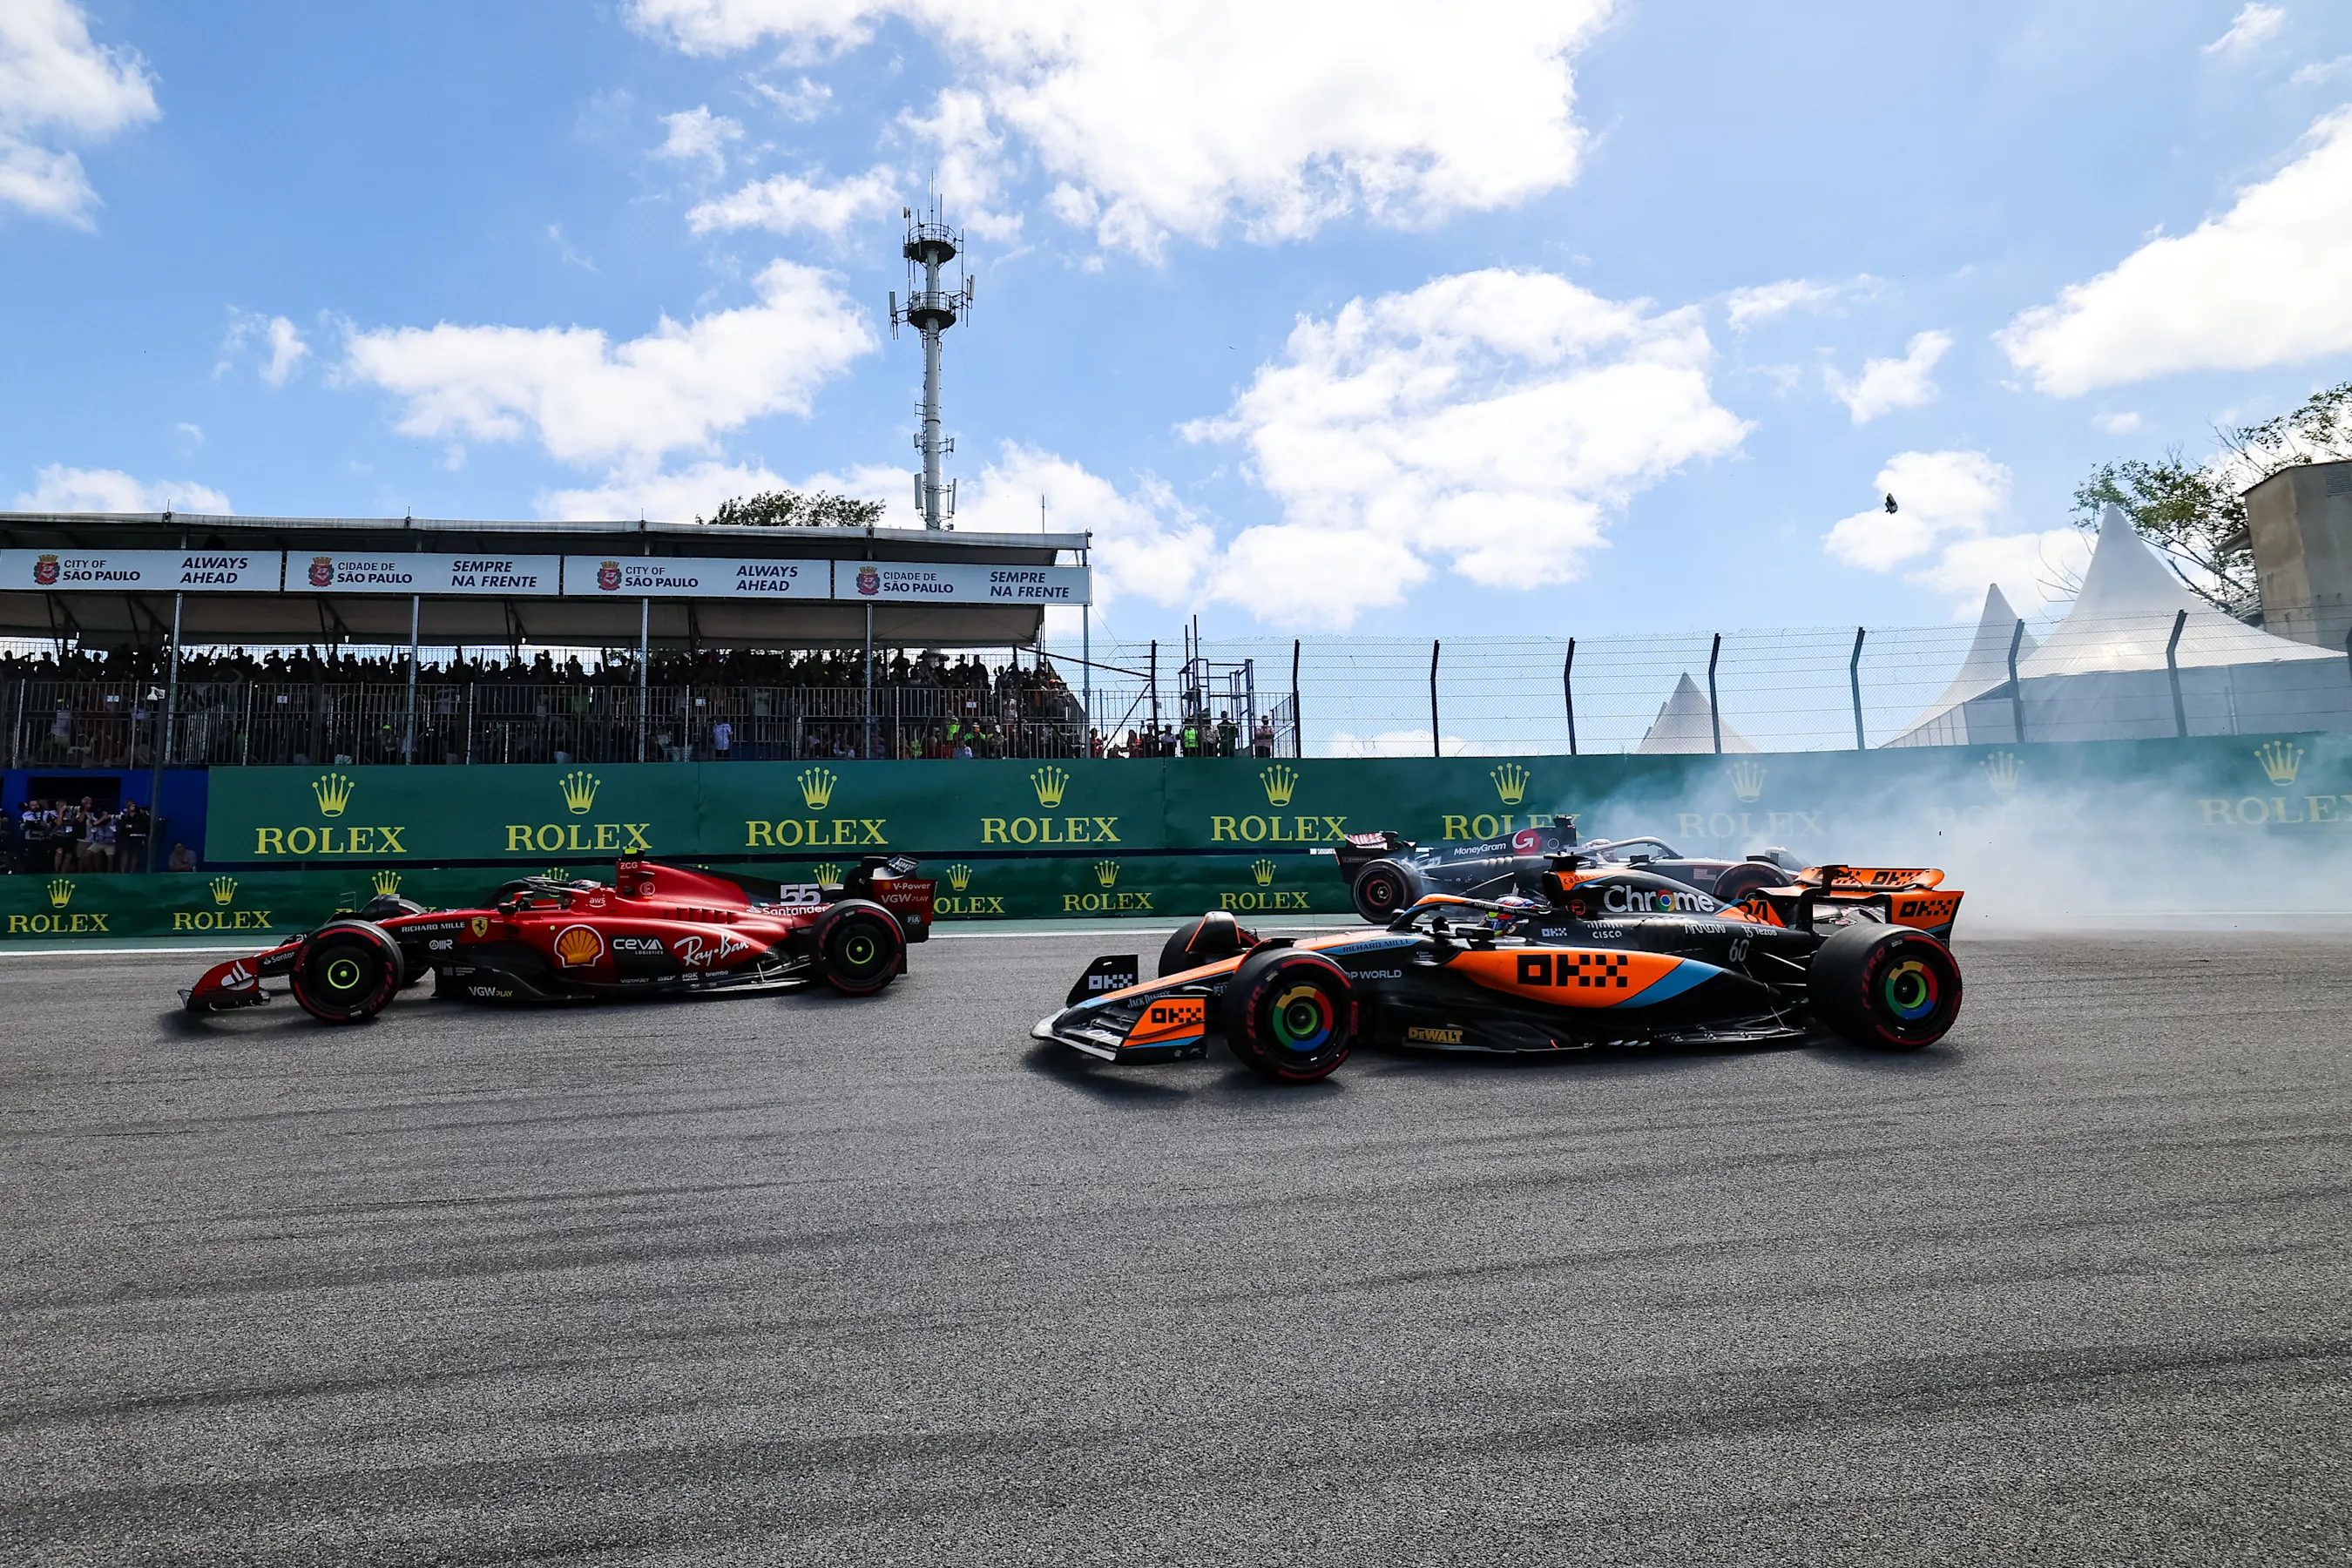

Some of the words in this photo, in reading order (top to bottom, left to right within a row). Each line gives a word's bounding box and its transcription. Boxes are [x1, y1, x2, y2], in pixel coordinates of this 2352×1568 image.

[64, 559, 91, 569] CITY
[91, 559, 106, 569] OF
[181, 558, 248, 569] ALWAYS
[338, 562, 378, 571] CIDADE
[381, 562, 395, 572] DE
[452, 560, 513, 572] SEMPRE
[62, 568, 94, 581] SÃO
[96, 571, 140, 581] PAULO
[337, 571, 366, 583] SÃO
[368, 573, 412, 584] PAULO
[625, 566, 648, 576] CITY
[651, 567, 666, 576] OF
[736, 564, 798, 578] ALWAYS
[883, 571, 921, 580] CIDADE
[923, 571, 937, 581] DE
[990, 571, 1046, 584] SEMPRE
[180, 572, 239, 584] AHEAD
[451, 575, 477, 587] NA
[481, 575, 537, 588] FRENTE
[625, 575, 652, 588] SÃO
[655, 578, 699, 588] PAULO
[736, 579, 790, 592] AHEAD
[883, 580, 910, 592] SÃO
[912, 583, 954, 592] PAULO
[990, 585, 1012, 597] NA
[1017, 585, 1070, 598] FRENTE
[981, 817, 1121, 843] ROLEX
[1210, 815, 1348, 841] ROLEX
[1676, 812, 1828, 838] ROLEX
[505, 823, 652, 851] ROLEX
[746, 820, 889, 846] ROLEX
[254, 827, 407, 854] ROLEX
[1454, 841, 1506, 856] MoneyGram
[620, 862, 638, 870] ZCG
[1870, 870, 1924, 885] OKX
[589, 896, 606, 905] aws
[781, 883, 821, 906] 55
[881, 894, 911, 903] VGW
[1220, 891, 1310, 911] ROLEX
[1603, 885, 1715, 913] Chrome
[932, 896, 1005, 914] OLEX
[1063, 892, 1153, 912] ROLEX
[1899, 899, 1954, 917] OKX
[762, 905, 827, 916] Santander
[8, 914, 109, 934] ROLEX
[172, 910, 273, 930] ROLEX
[402, 923, 438, 933] RICHARD
[440, 922, 465, 930] MILLE
[1541, 927, 1568, 937] OKX
[1342, 942, 1382, 953] RICHARD
[1384, 939, 1411, 949] MILLE
[1729, 938, 1750, 963] 60
[1360, 969, 1402, 979] WORLD
[1517, 954, 1627, 988] OKX
[1089, 973, 1132, 990] OKX
[469, 986, 496, 997] VGW
[1151, 1008, 1202, 1024] OKX
